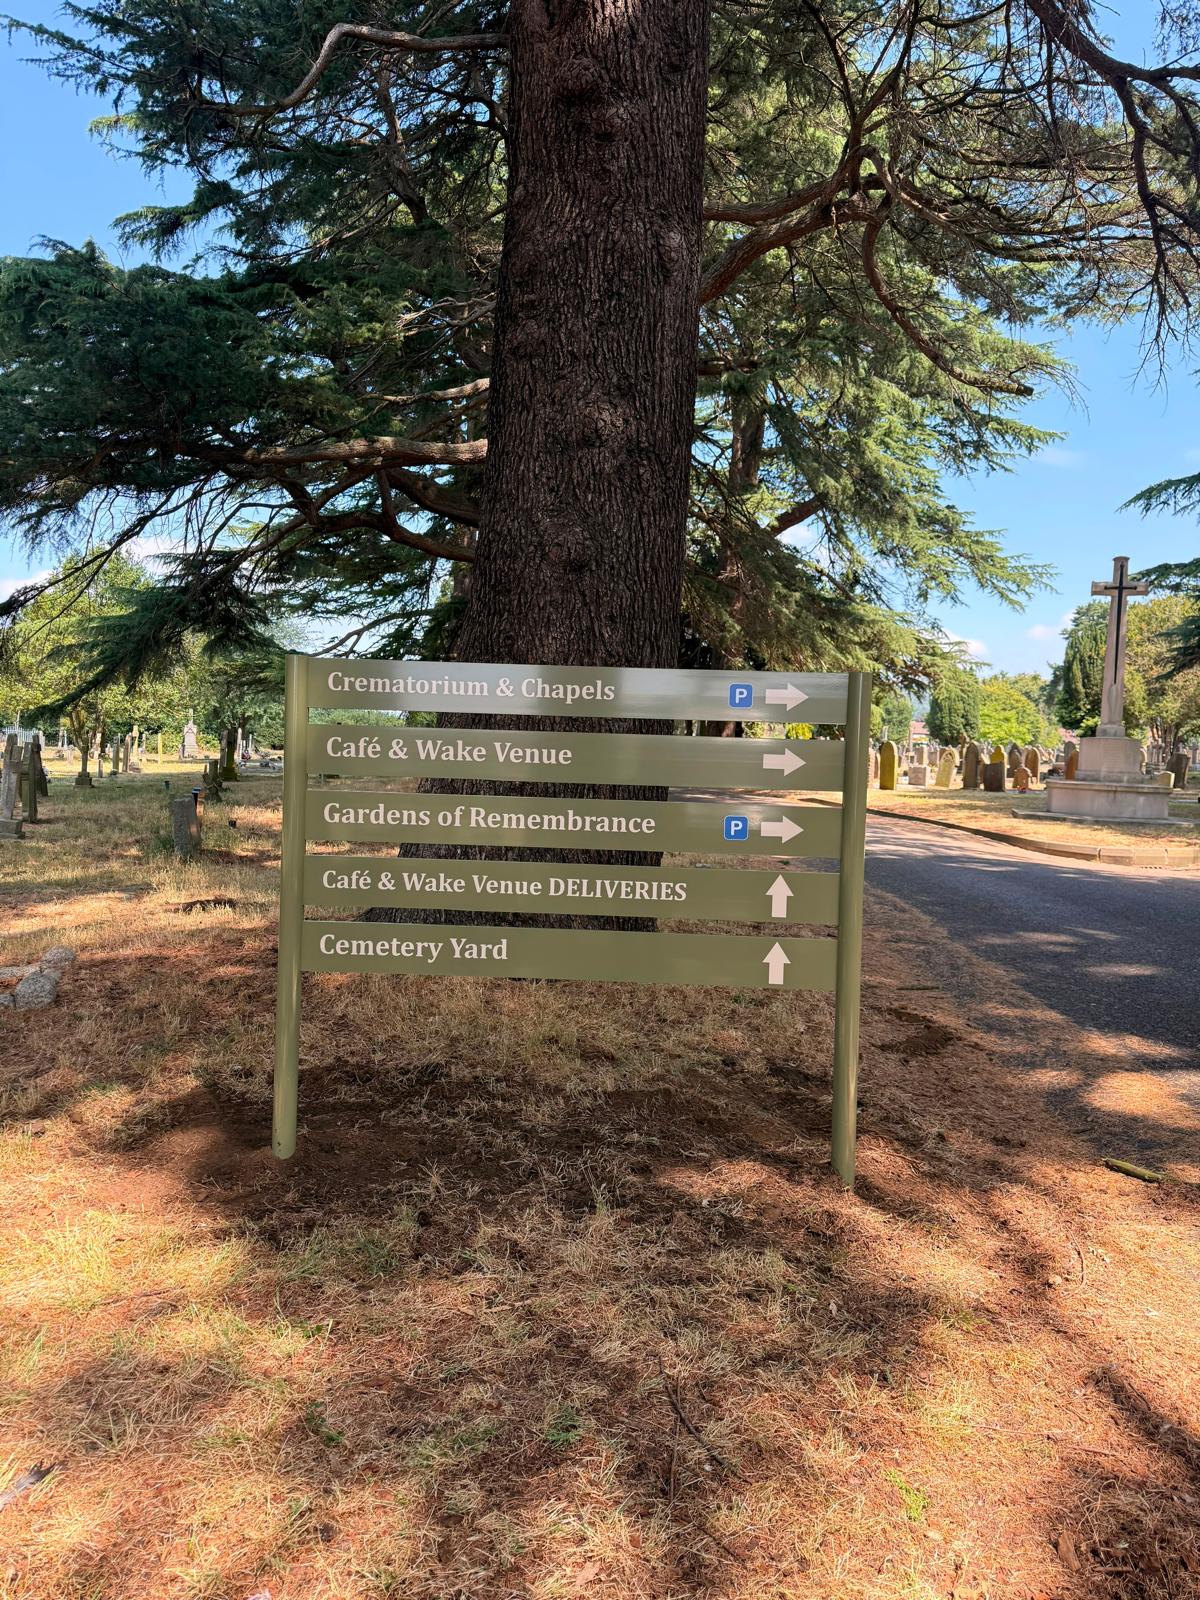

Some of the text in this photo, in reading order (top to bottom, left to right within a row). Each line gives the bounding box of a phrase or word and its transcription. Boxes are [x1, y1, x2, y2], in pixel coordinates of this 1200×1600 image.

[327, 671, 615, 703] Crematorium & Chapels
[735, 688, 748, 703] P
[326, 736, 572, 764] Café & Wake Venue
[323, 802, 656, 833] Gardens of Remembrance
[730, 820, 743, 835] P
[322, 870, 687, 901] Café & Wake Venue DELIVERIES
[319, 934, 508, 963] Cemetery Yard
